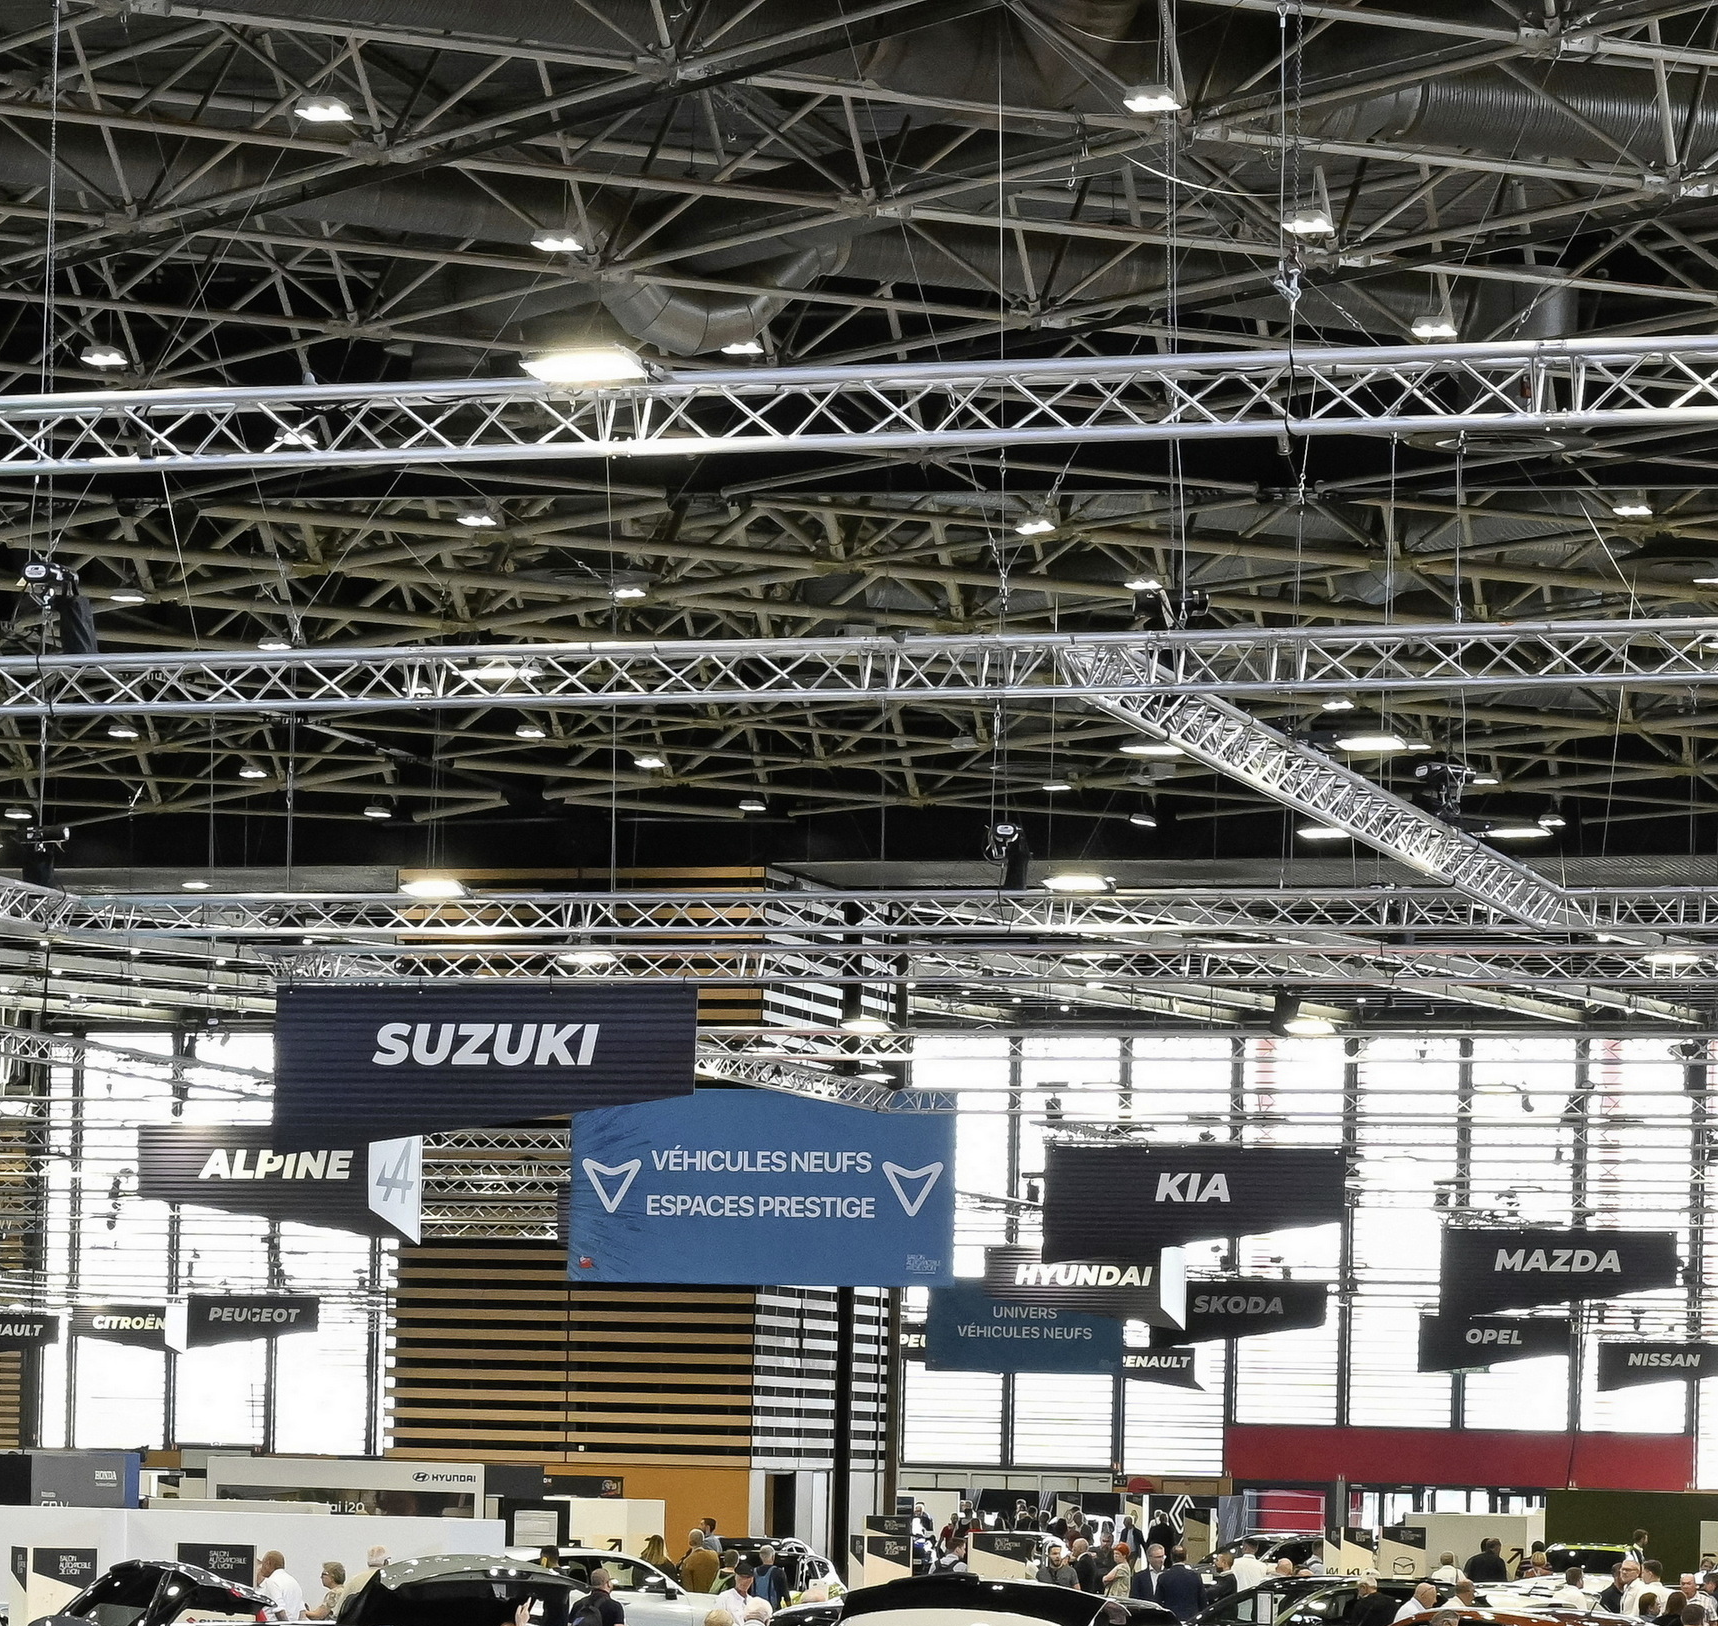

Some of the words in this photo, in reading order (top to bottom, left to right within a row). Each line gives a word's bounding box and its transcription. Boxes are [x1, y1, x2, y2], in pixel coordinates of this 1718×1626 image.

[372, 1022, 601, 1067] SUZUKI
[198, 1148, 354, 1182] ALPINE
[651, 1147, 787, 1173] VÉHICULES
[790, 1152, 873, 1175] NEUFS
[1155, 1172, 1231, 1204] KIA
[645, 1194, 755, 1218] ESPACES
[758, 1196, 876, 1220] PRESTIGE
[1494, 1247, 1622, 1274] MAZDA
[1014, 1263, 1153, 1288] HYUNDAI
[208, 1306, 300, 1323] PEUGEOT
[993, 1306, 1058, 1320] UNIVERS
[1193, 1294, 1284, 1316] SKODA
[92, 1310, 167, 1331] CITROËN
[957, 1321, 1039, 1340] VÉHICULES
[1043, 1324, 1093, 1340] NEUFS
[1465, 1328, 1522, 1346] OPEL
[1627, 1352, 1701, 1369] NISSAN
[431, 1474, 476, 1483] HYUNDAI
